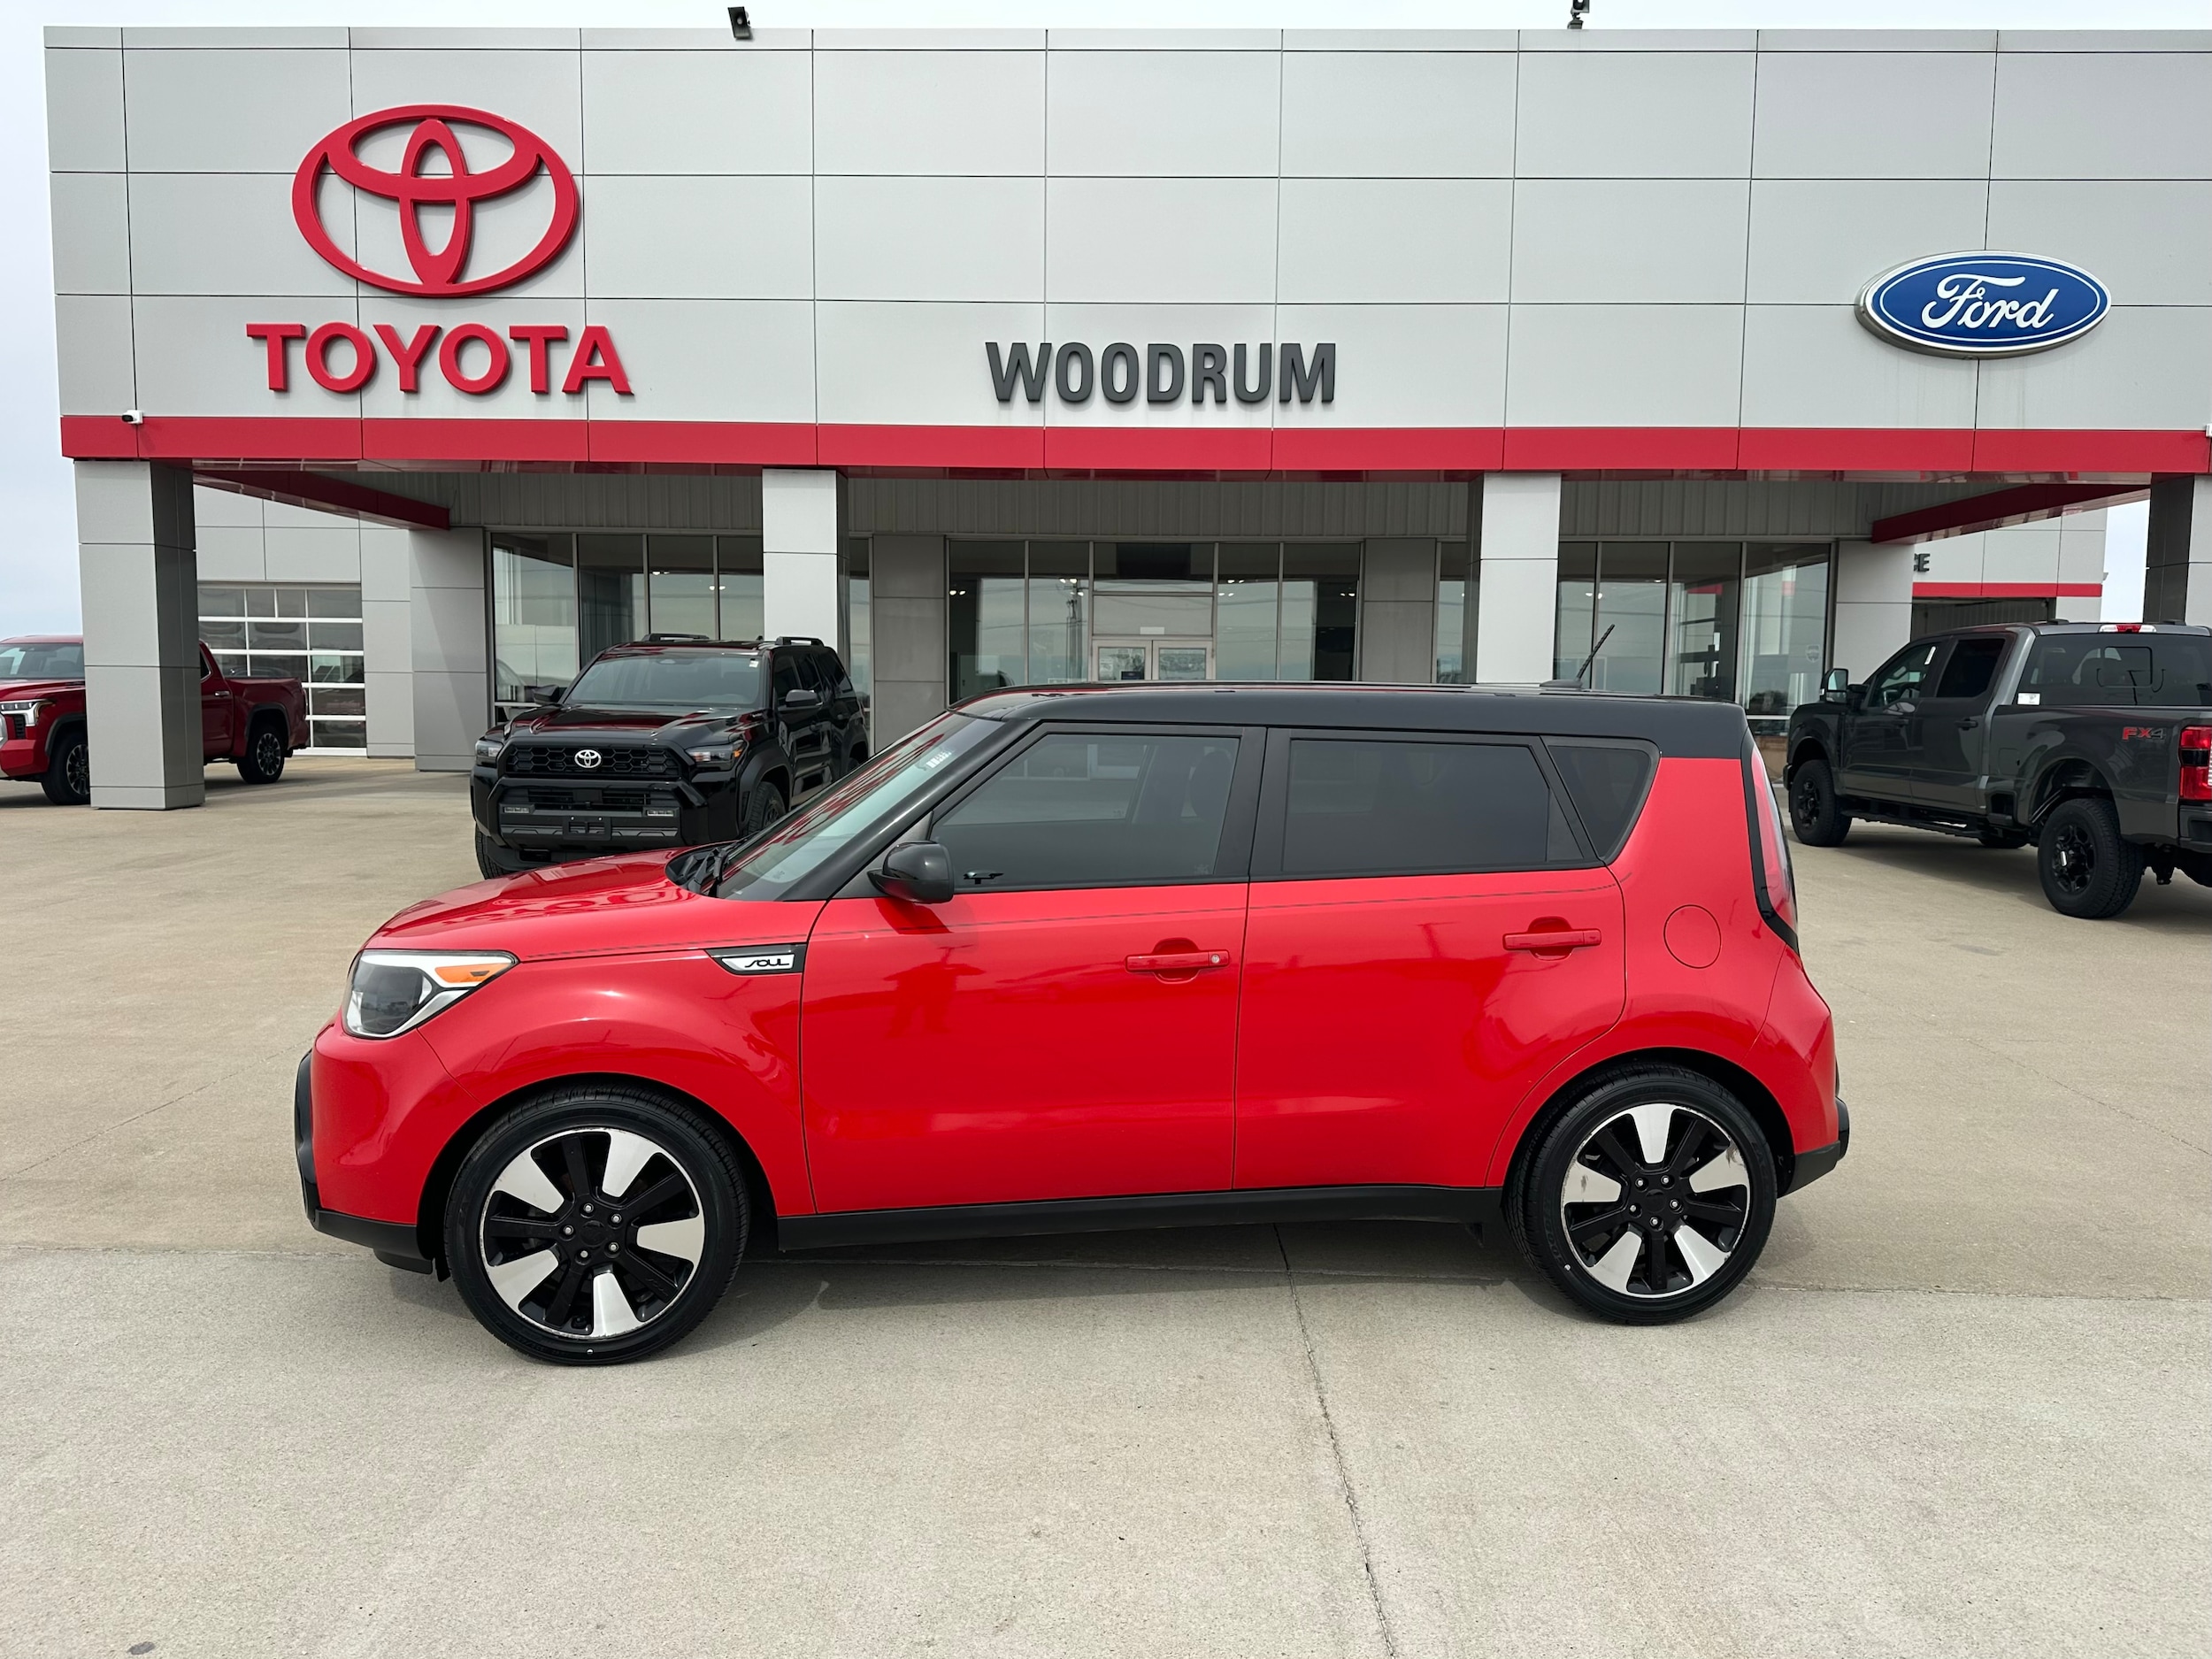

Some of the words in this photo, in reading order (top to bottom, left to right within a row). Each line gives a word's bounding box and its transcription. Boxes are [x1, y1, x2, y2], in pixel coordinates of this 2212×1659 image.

[1921, 273, 2059, 329] Ford
[246, 321, 634, 395] TOYOTA
[985, 342, 1336, 403] WOODRUM
[2123, 726, 2166, 741] FX4
[744, 958, 790, 968] SOUL
